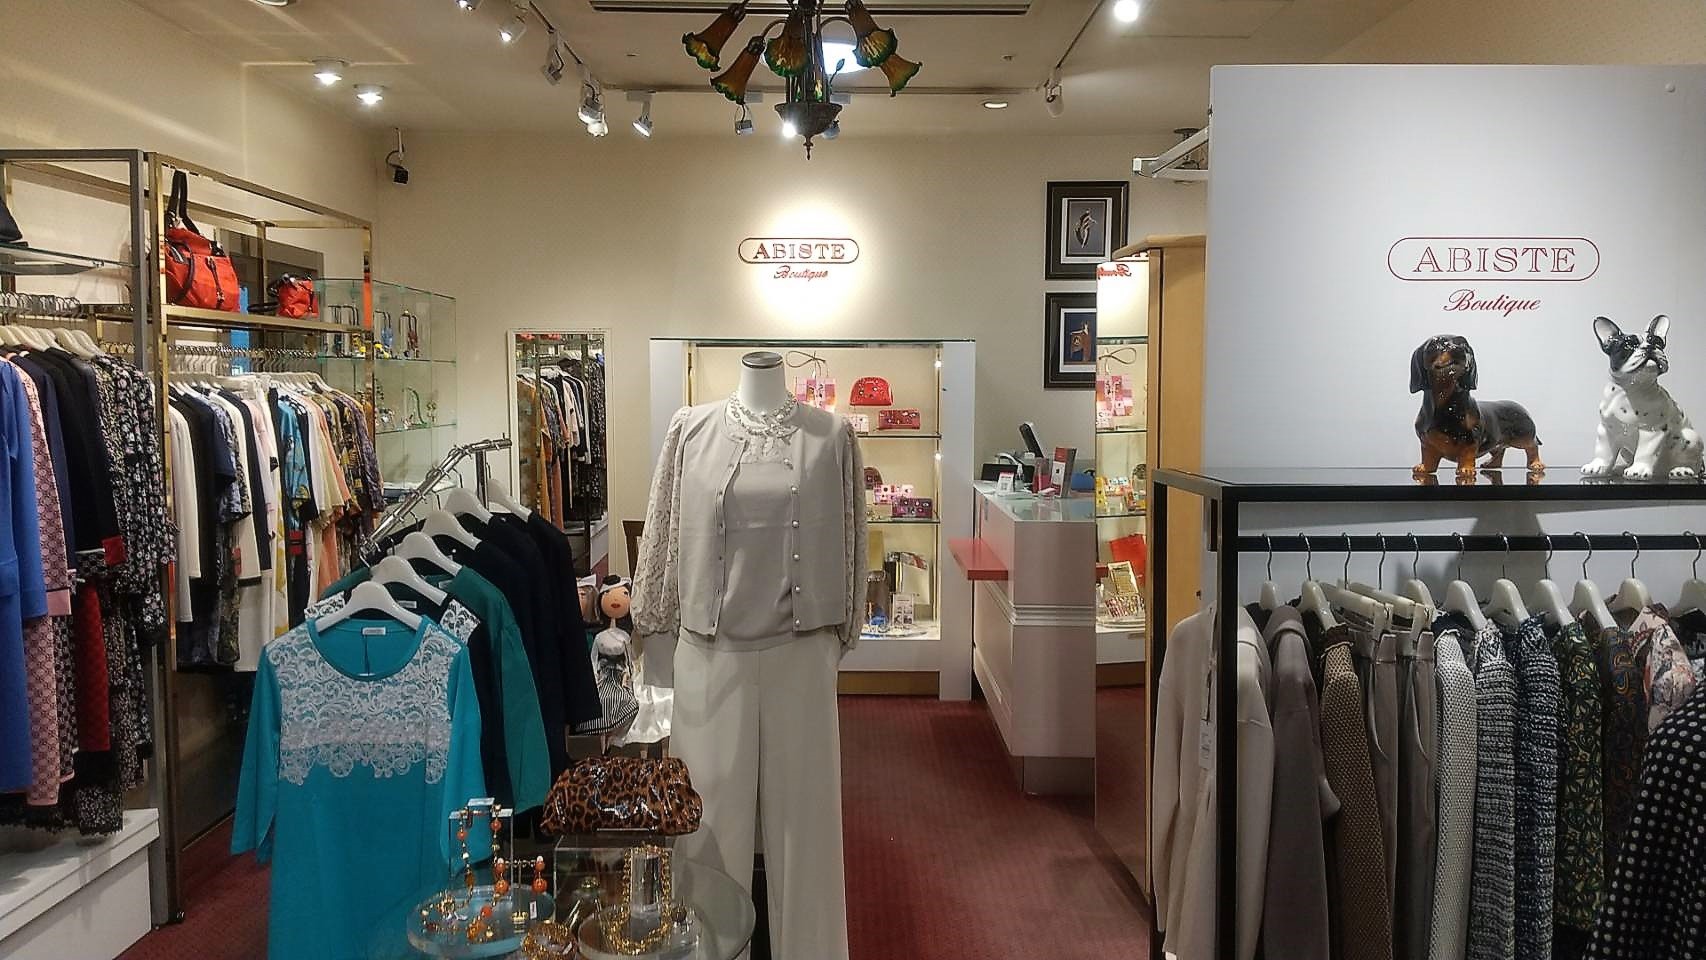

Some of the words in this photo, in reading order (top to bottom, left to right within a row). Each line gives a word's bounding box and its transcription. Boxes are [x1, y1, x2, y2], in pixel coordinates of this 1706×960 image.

[753, 243, 845, 260] ABISTE
[1412, 246, 1576, 273] ABISTE
[774, 265, 828, 281] Boutique
[1443, 288, 1541, 317] Boutique
